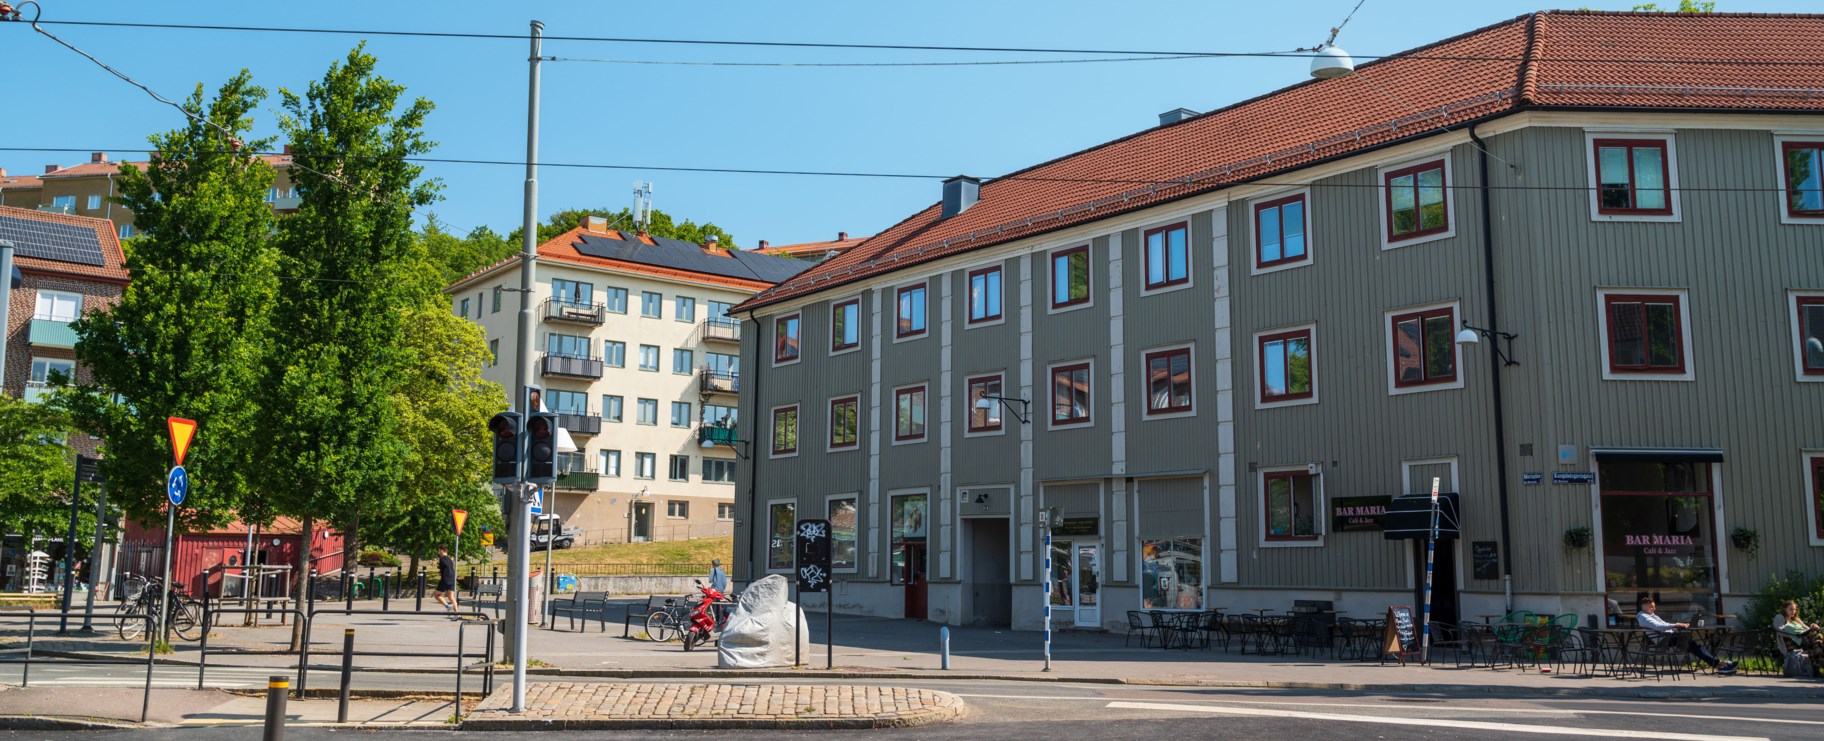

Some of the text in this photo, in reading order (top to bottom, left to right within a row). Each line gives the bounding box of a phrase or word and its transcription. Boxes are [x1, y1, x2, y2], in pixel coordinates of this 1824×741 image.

[1336, 506, 1386, 516] BAR MARIA
[1626, 535, 1693, 544] BAR MARIA
